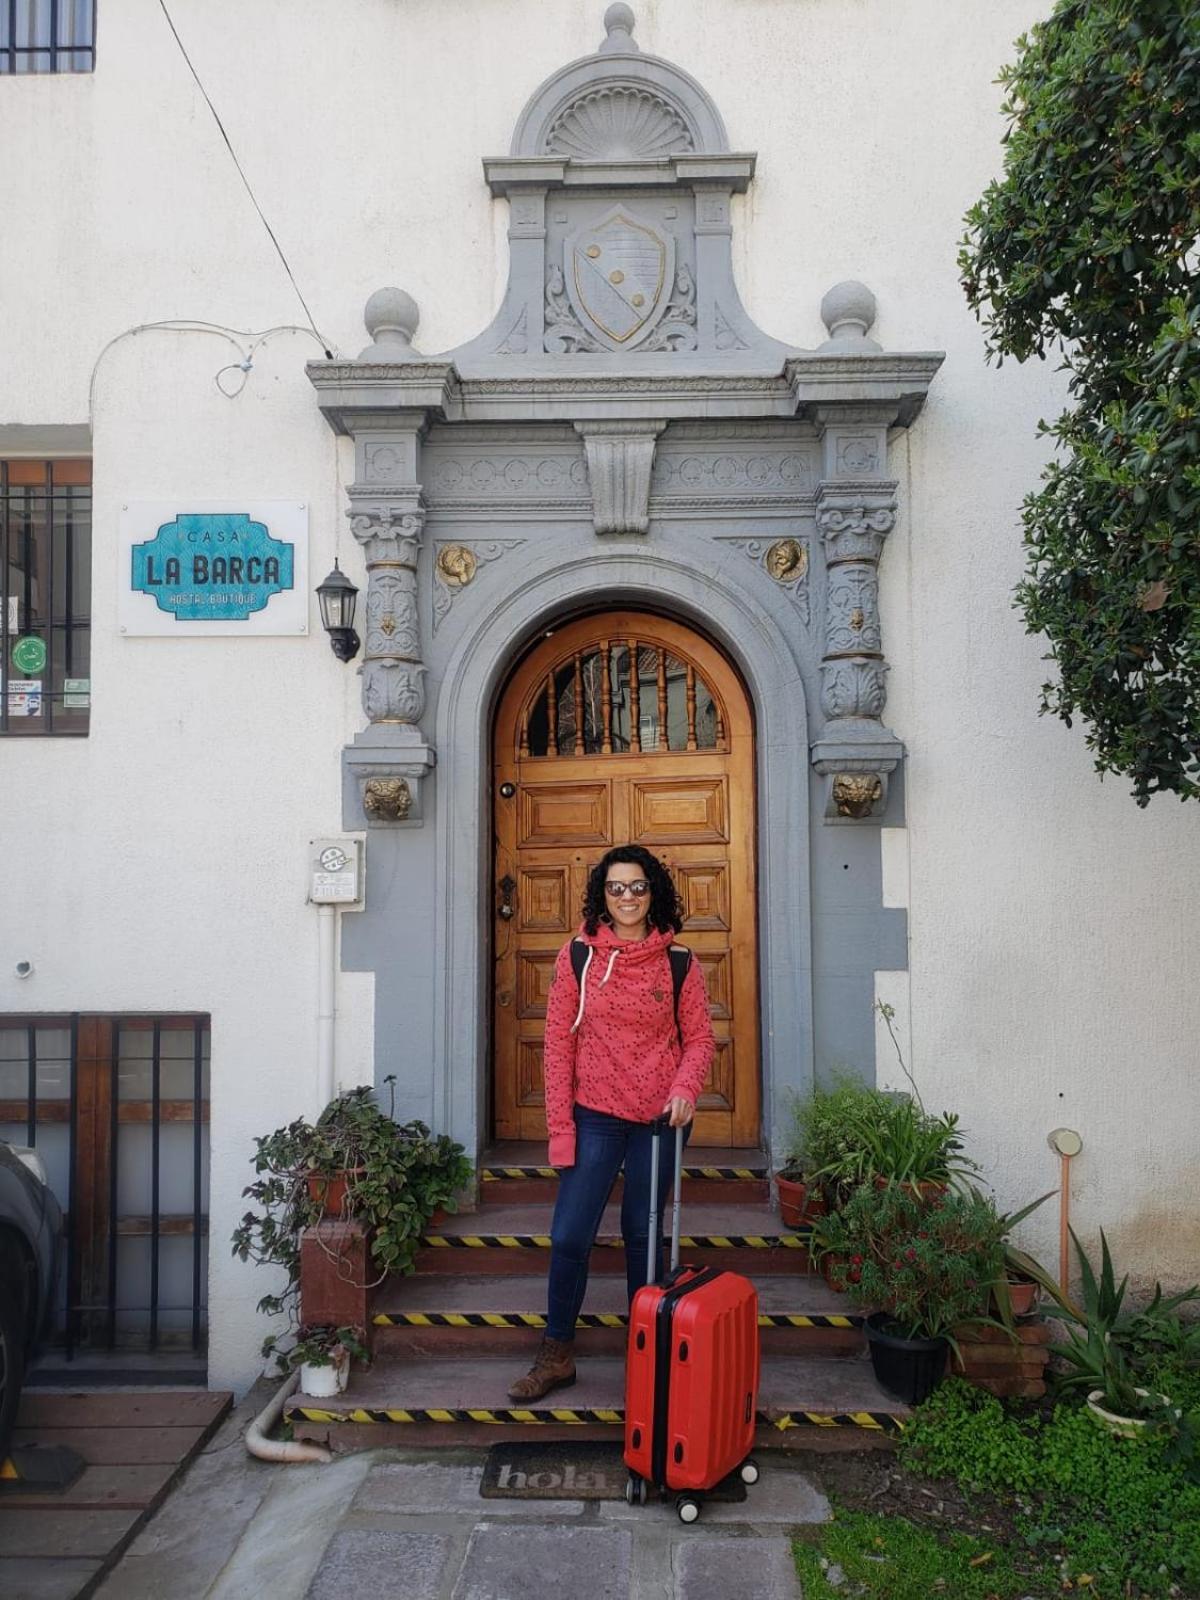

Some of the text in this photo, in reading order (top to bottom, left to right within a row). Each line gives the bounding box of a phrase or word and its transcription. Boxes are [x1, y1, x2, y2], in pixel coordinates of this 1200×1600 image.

[187, 531, 239, 543] CASA
[147, 555, 279, 586] LA BARCA
[170, 592, 257, 604] HOSTAL BOUTIQUE
